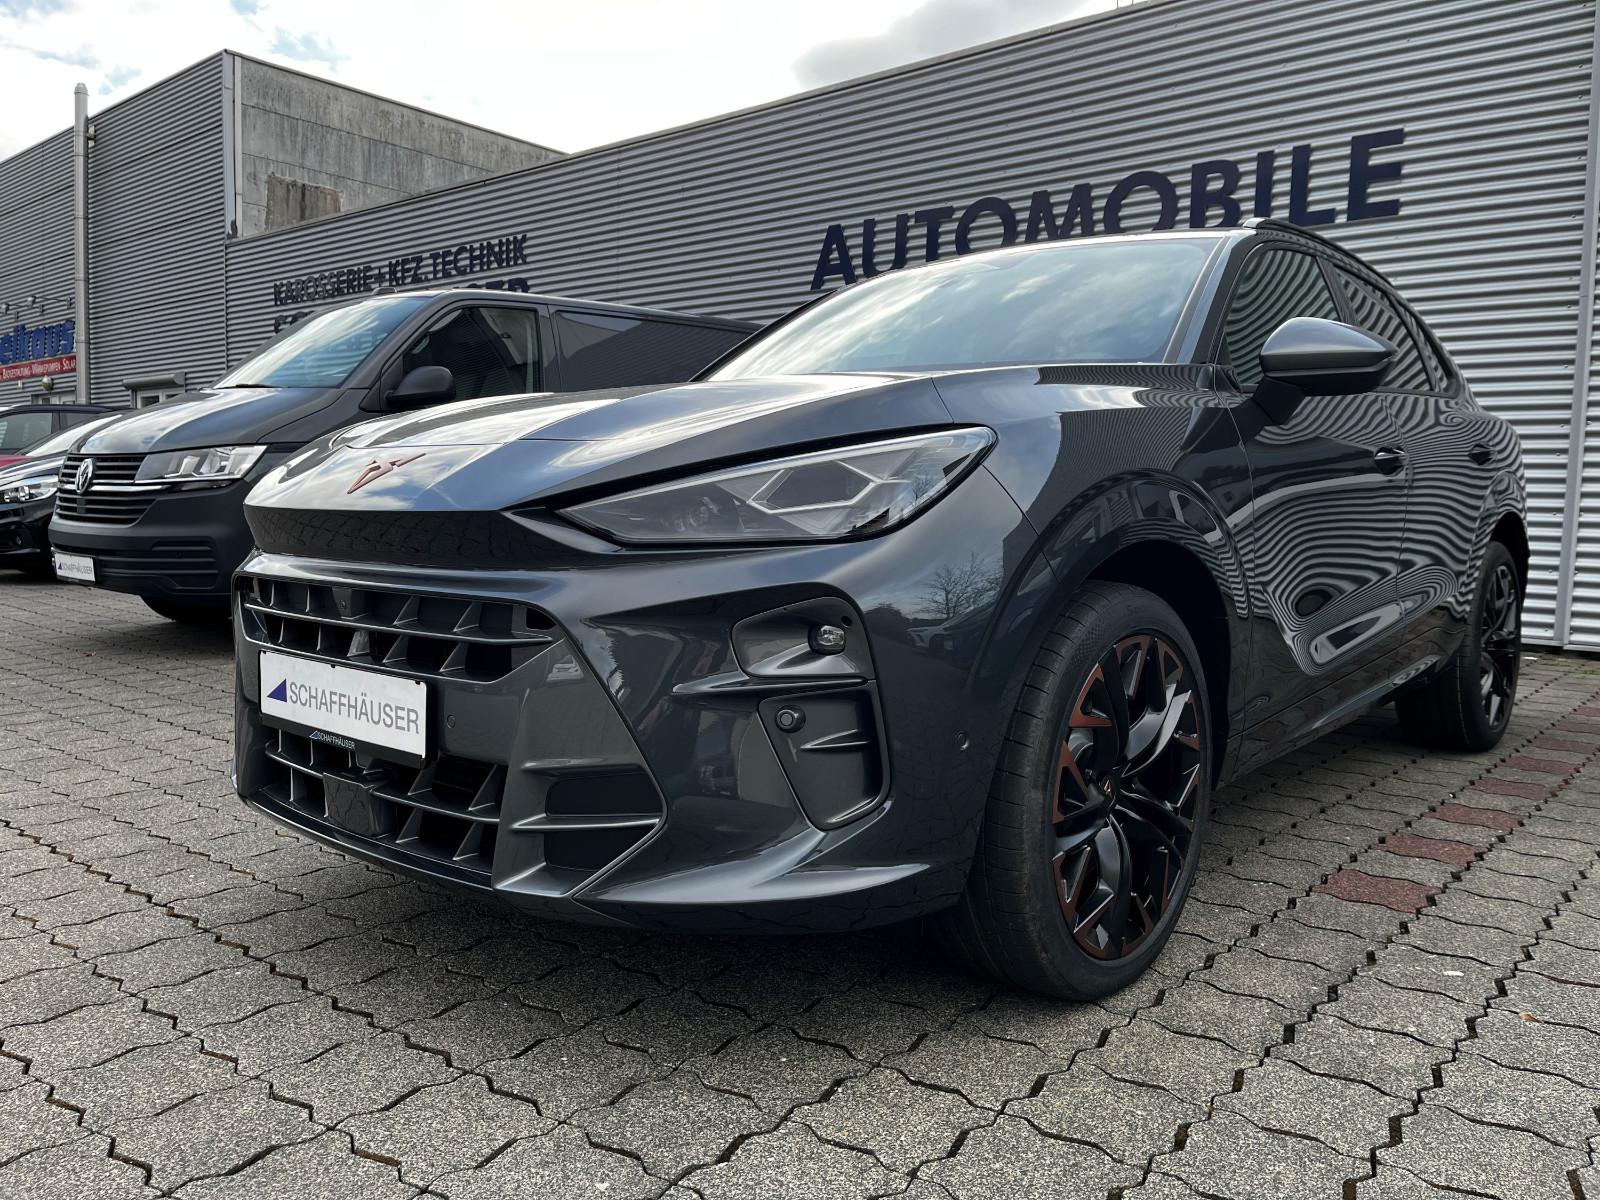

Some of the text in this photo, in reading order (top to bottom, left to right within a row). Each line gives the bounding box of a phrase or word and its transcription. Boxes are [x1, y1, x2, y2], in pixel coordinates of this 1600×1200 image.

[810, 128, 1406, 291] AUTOMOBILE
[274, 265, 373, 306] KAROSSERIE
[289, 681, 420, 734] SCHAFFHÄUSER
[318, 731, 356, 750] SCHAFFHÄUSER
